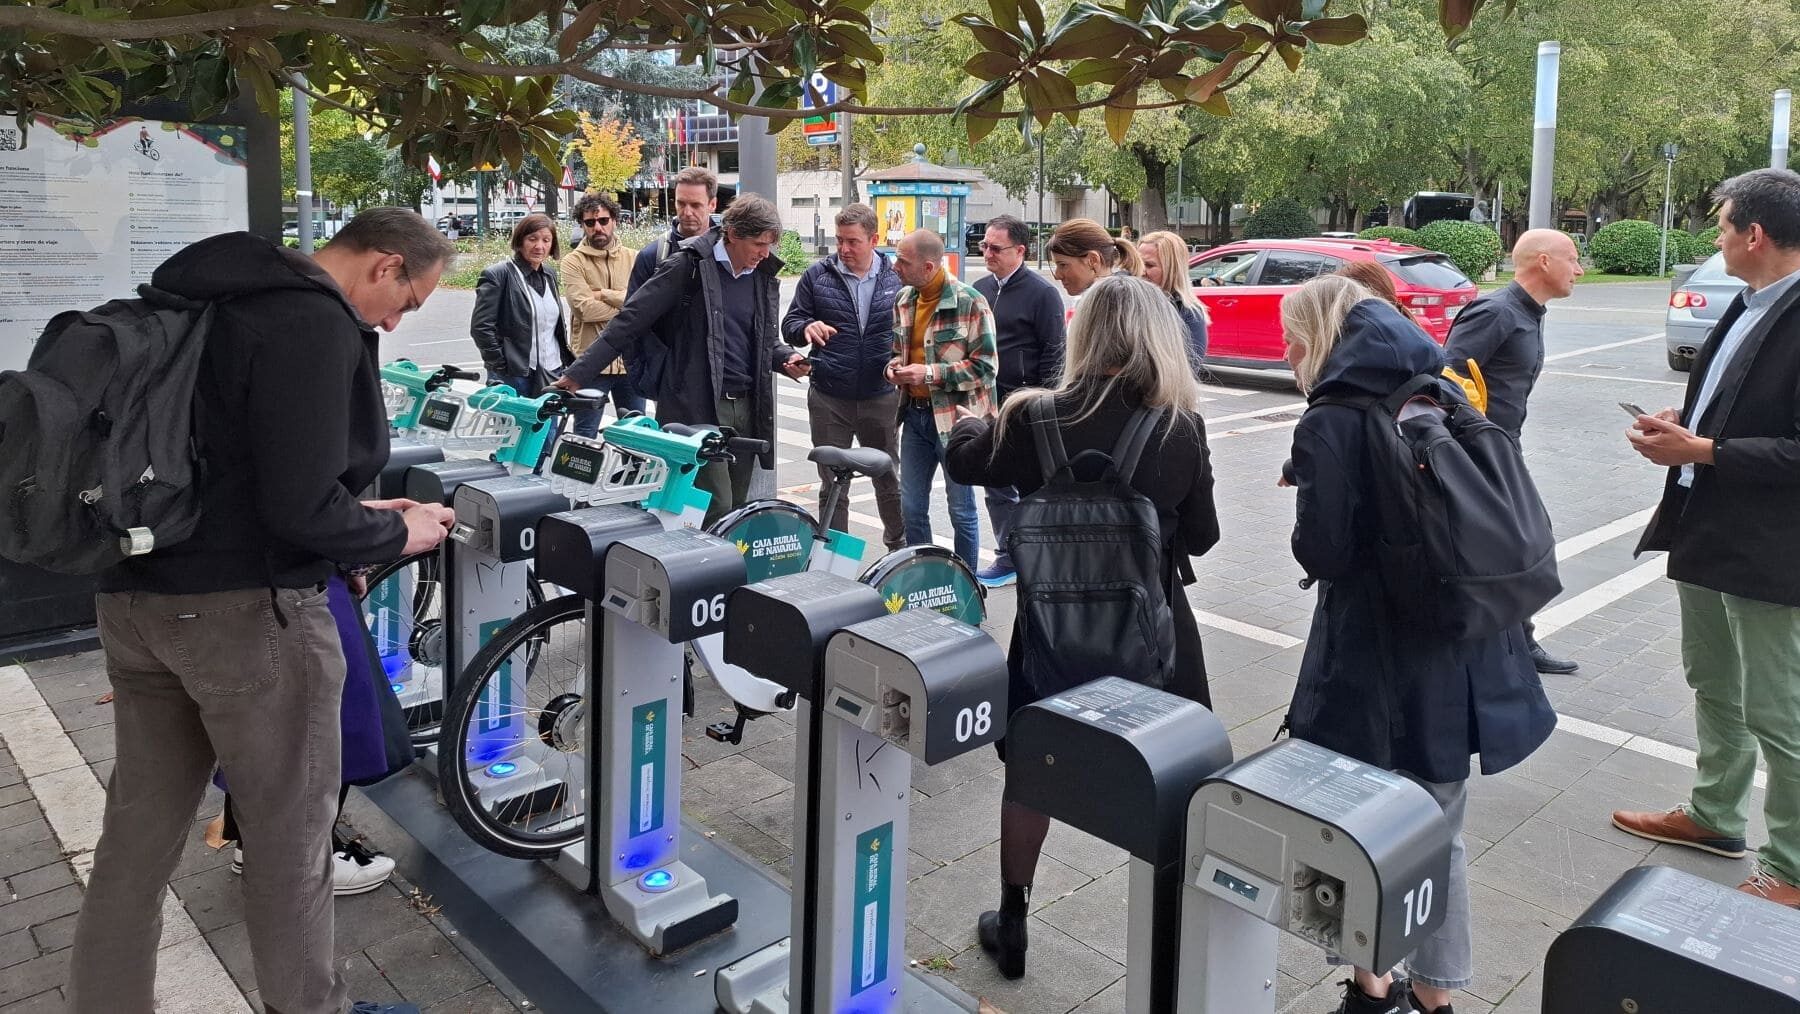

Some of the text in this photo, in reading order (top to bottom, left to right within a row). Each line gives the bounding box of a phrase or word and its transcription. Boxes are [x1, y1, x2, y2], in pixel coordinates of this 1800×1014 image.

[752, 533, 800, 549] CAJA RURAL
[752, 542, 802, 557] DE NAVARRA
[908, 584, 955, 602] CAJA RURAL
[908, 601, 920, 610] DE
[921, 593, 958, 609] NAVARRA
[691, 593, 726, 627] 06
[955, 701, 992, 743] 08
[1403, 878, 1433, 937] 10
